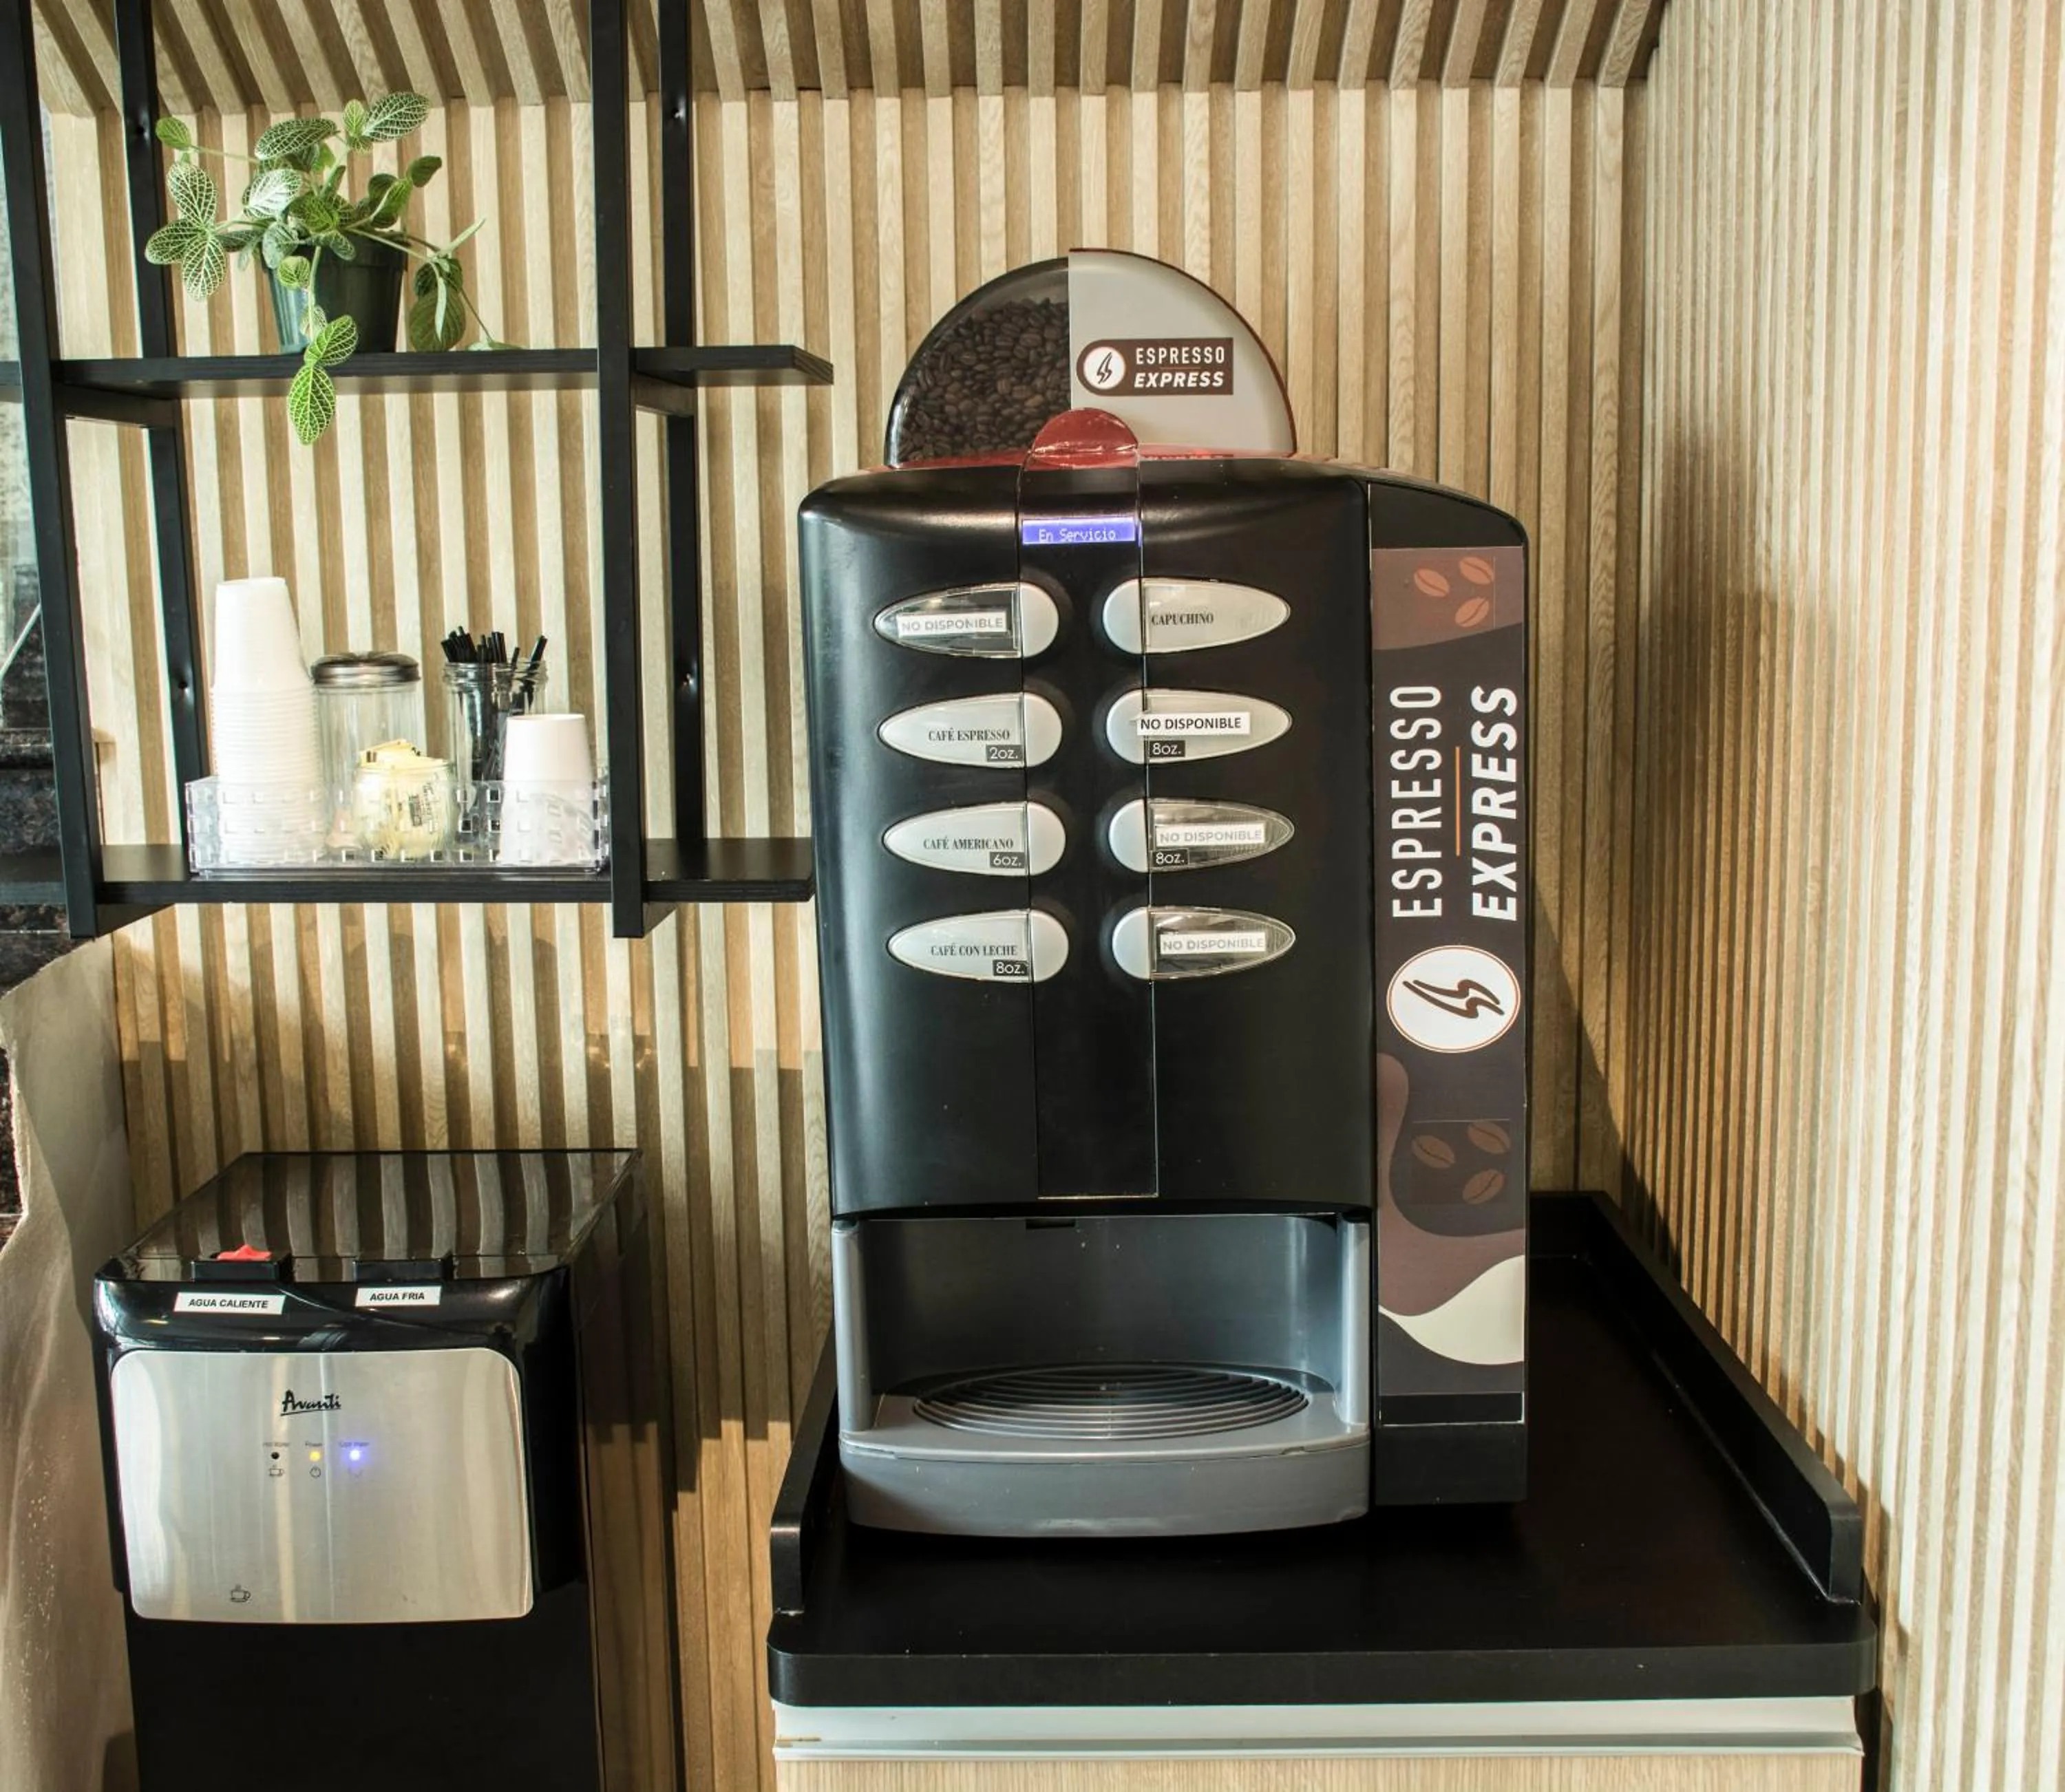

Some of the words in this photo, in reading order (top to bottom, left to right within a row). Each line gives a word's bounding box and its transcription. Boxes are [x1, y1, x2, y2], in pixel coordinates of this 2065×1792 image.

[1136, 346, 1225, 364] ESPRESSO
[1134, 372, 1225, 388] EXPRESS
[1038, 529, 1053, 543] En
[1059, 528, 1116, 542] Servicio
[902, 621, 920, 630] NO
[924, 617, 1003, 629] DISPONIBLE
[1152, 613, 1214, 625] CAPUCHINO
[1140, 718, 1161, 729] NO
[1165, 717, 1241, 729] DISPONIBLE
[928, 728, 955, 741] CAFÉ
[957, 729, 1010, 741] ESPRESSO
[990, 747, 1018, 760] 2oz.
[1152, 743, 1182, 756] 8oz.
[1390, 685, 1443, 918] ESPRESSO
[1471, 685, 1518, 921] EXPRESS
[923, 836, 949, 849] CAFÉ
[952, 838, 1013, 849] AMERICANO
[1160, 831, 1180, 843] NO
[1184, 829, 1262, 842] DISPONIBLE
[993, 855, 1022, 867] 6oz.
[1155, 853, 1185, 864] 8oz.
[931, 943, 956, 956] CAFÉ
[959, 946, 980, 956] CON
[983, 945, 1018, 956] LECHE
[1163, 941, 1183, 950] NO
[1187, 938, 1264, 950] DISPONIBLE
[996, 961, 1025, 974] 8oz.
[370, 1292, 399, 1301] AGUA
[402, 1291, 425, 1301] FRIA
[188, 1299, 217, 1308] AGUA
[219, 1299, 268, 1309] CALIENTE
[281, 1389, 341, 1415] Avanti
